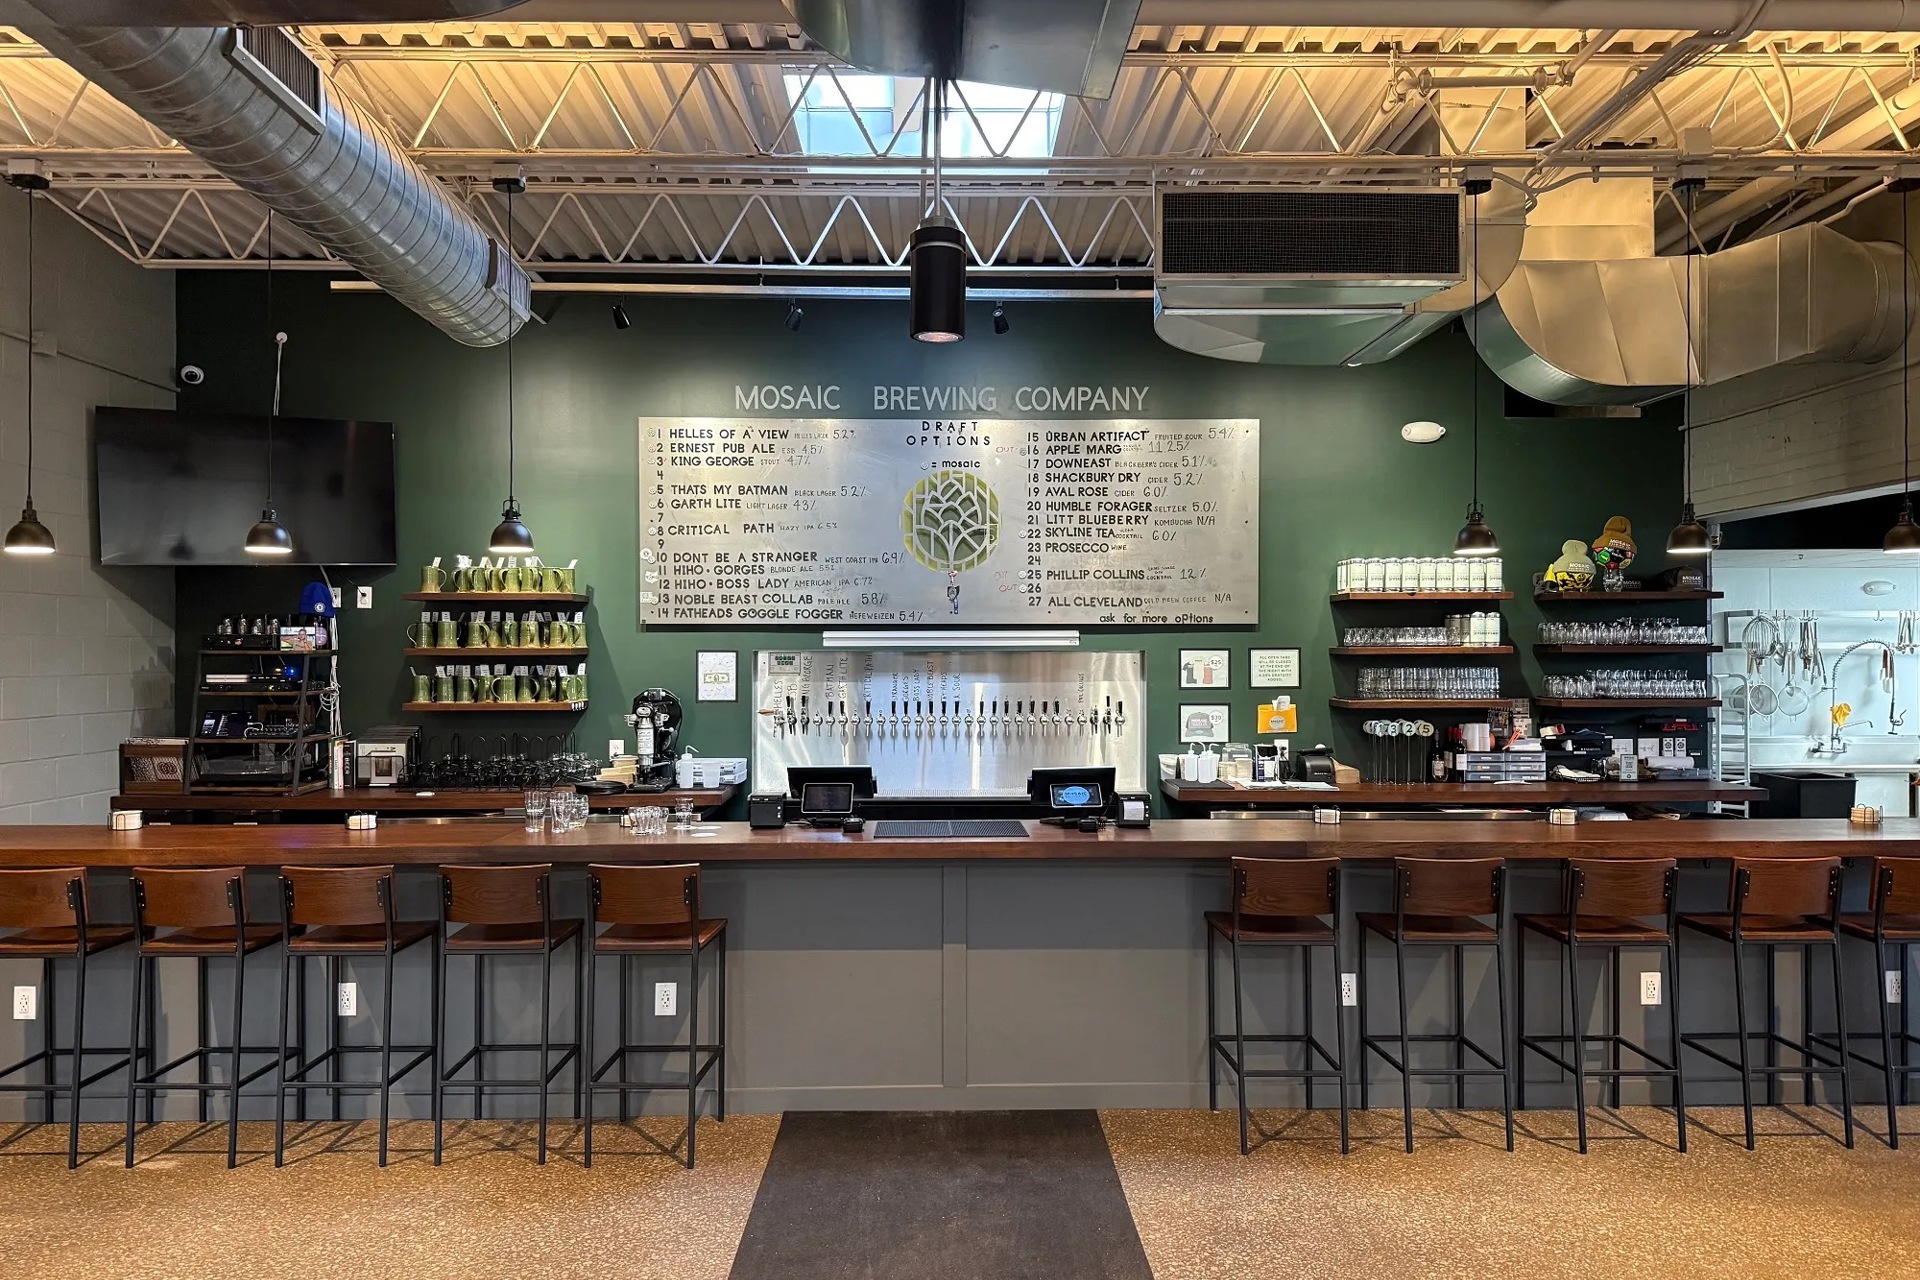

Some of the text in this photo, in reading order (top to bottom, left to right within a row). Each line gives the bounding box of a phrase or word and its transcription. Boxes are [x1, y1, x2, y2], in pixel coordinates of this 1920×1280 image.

[734, 385, 1150, 411] MOSAIC BREWING COMPANY
[922, 421, 978, 432] DRAFT
[657, 429, 661, 438] 1
[669, 429, 713, 439] HELLES
[719, 429, 736, 439] OF
[758, 429, 790, 439] VIEW
[1027, 432, 1039, 442] 15
[1045, 431, 1086, 442] URBAN
[1090, 431, 1147, 441] ARTIFACT
[906, 435, 990, 446] OPTIONS
[656, 443, 664, 453] 2
[670, 443, 715, 453] ERNEST
[722, 443, 745, 453] PUB
[752, 444, 776, 453] ALE
[801, 444, 824, 454] 4.5%
[1027, 445, 1040, 455] 16
[1046, 445, 1081, 455] APPLE
[1086, 445, 1122, 455] MARG
[656, 457, 664, 466] 3
[671, 456, 701, 466] KING
[705, 456, 754, 466] GEORGE
[942, 460, 981, 468] mosaic
[1027, 459, 1040, 469] 17
[1045, 458, 1111, 469] DOWNEAST
[657, 470, 664, 480] 4
[1027, 473, 1040, 483] 18
[1045, 473, 1115, 483] SHACKBURY
[1118, 472, 1141, 483] DRY
[656, 485, 664, 495] 5
[671, 485, 707, 495] THATS
[713, 485, 732, 495] MY
[738, 485, 788, 495] BATMAN
[817, 489, 837, 497] LAGER
[1028, 487, 1040, 497] 19
[1045, 487, 1074, 497] AVAL
[1078, 487, 1109, 497] ROSE
[1143, 486, 1168, 498] 6.0%
[656, 499, 664, 509] 6
[671, 499, 711, 509] GARTH
[715, 499, 741, 509] LITE
[1027, 501, 1041, 511] 20
[1046, 501, 1092, 512] HUMBLE
[1097, 501, 1152, 512] FORAGER
[1192, 501, 1218, 513] 5.0%
[657, 513, 664, 522] 7
[1027, 515, 1215, 526] 21 LITT BLUEBERRY KOMBUCHA N/A
[657, 526, 664, 536] 8
[667, 524, 730, 535] CRITICAL
[743, 523, 774, 534] PATH
[1027, 529, 1041, 539] 22
[1045, 527, 1092, 537] SKYLINE
[1095, 528, 1115, 538] TEA
[657, 538, 665, 549] 9
[1027, 543, 1041, 553] 23
[1045, 542, 1109, 553] PROSECCO
[656, 552, 667, 563] 10
[673, 552, 709, 563] DONT
[715, 552, 730, 563] BE
[737, 552, 746, 563] A
[751, 552, 818, 563] STRANGER
[881, 552, 905, 564] 6.9%
[1027, 555, 1041, 565] 24
[658, 565, 667, 575] 11
[674, 565, 703, 575] HIHO
[713, 565, 765, 575] GORGES
[1027, 569, 1041, 580] 25
[1046, 570, 1090, 580] PHILLIP
[1093, 569, 1145, 580] COLLINS
[659, 579, 670, 589] 12
[674, 579, 706, 589] HIHO
[716, 579, 750, 589] BOSS
[757, 579, 790, 588] LADY
[794, 579, 832, 587] AMERICAN
[1027, 583, 1041, 593] 26
[659, 593, 670, 603] 13
[675, 595, 715, 605] NOBLE
[721, 595, 758, 604] BEAST
[762, 594, 813, 604] COLLAB
[1028, 597, 1041, 607] 27
[1047, 596, 1071, 607] ALL
[1074, 596, 1143, 607] CLEVELAND
[1214, 593, 1231, 604] N/A
[657, 608, 925, 621] 14 FATHEADS GOGGLE FOGGER HEFEWEIZEN 5.4%
[1099, 613, 1115, 623] ask
[1123, 613, 1137, 623] for
[1142, 614, 1168, 623] more
[1406, 723, 1413, 733] 2
[1423, 724, 1430, 733] 5
